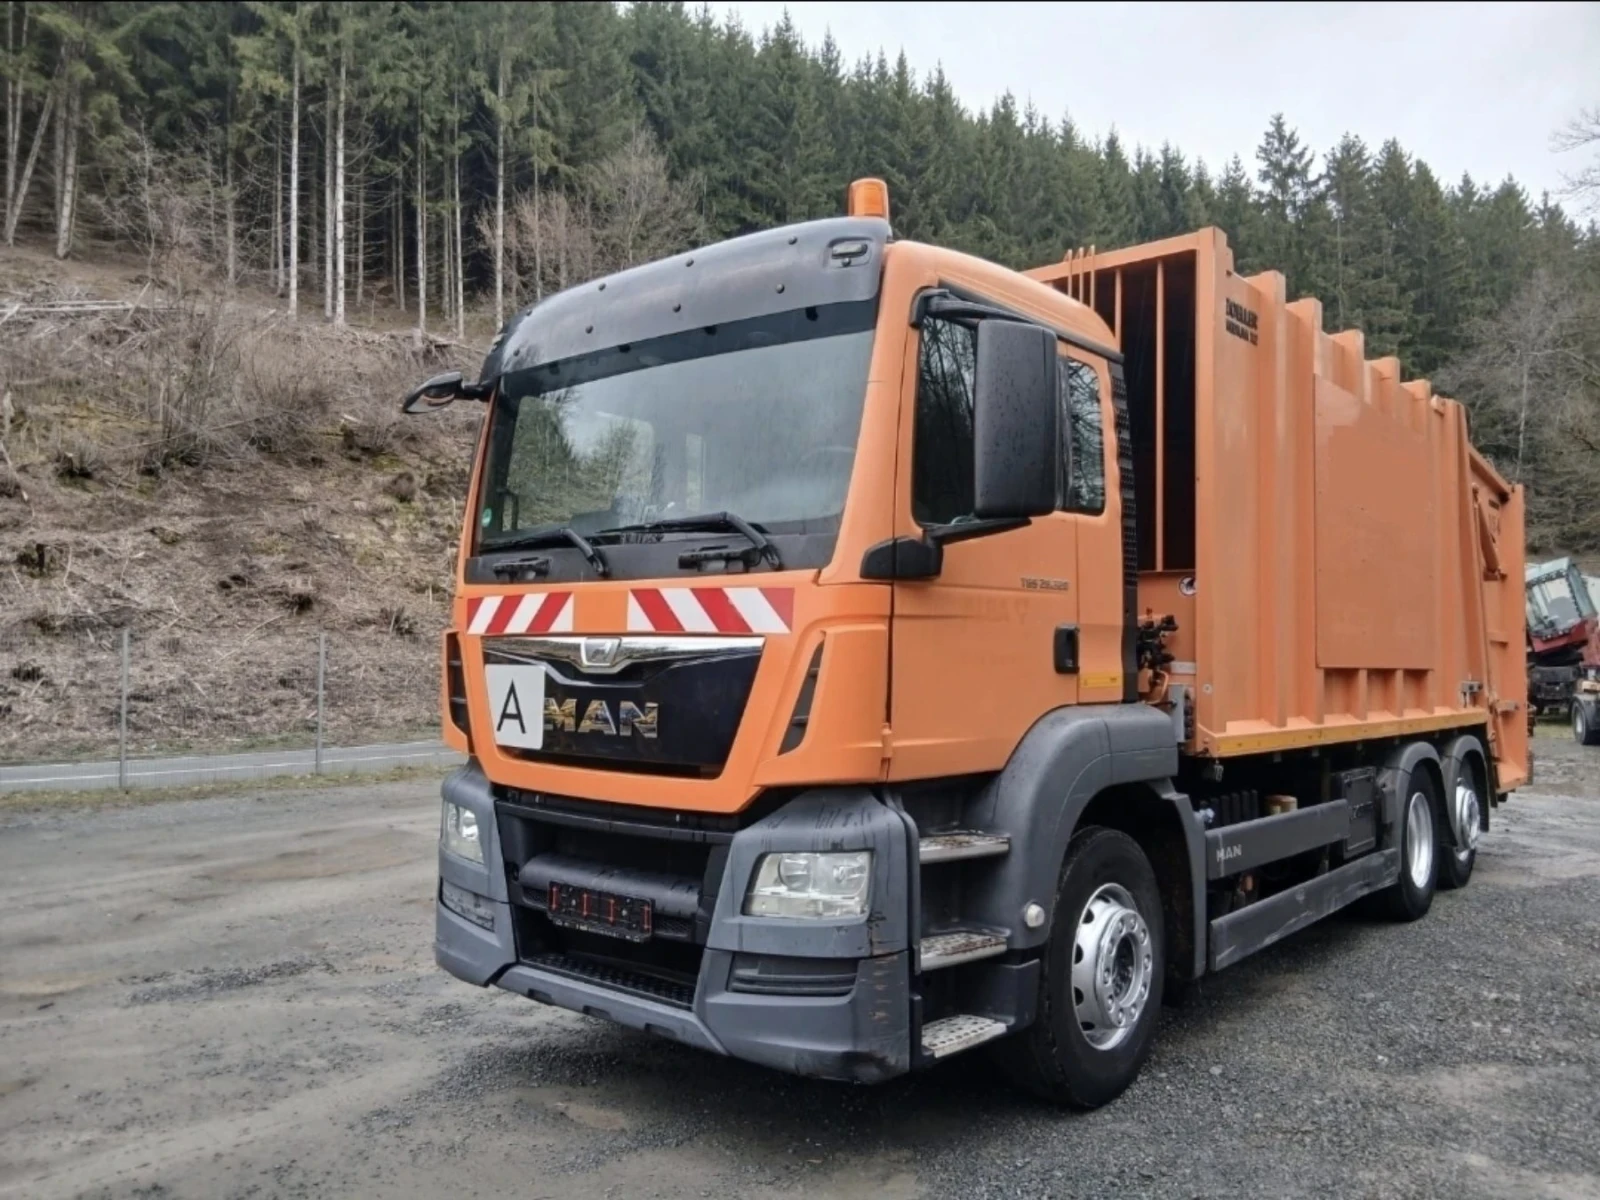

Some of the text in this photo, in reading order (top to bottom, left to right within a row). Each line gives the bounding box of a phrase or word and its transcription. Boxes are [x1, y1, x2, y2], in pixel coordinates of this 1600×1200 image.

[496, 679, 527, 734] A
[543, 697, 659, 738] MAN
[1216, 844, 1242, 862] MAN
